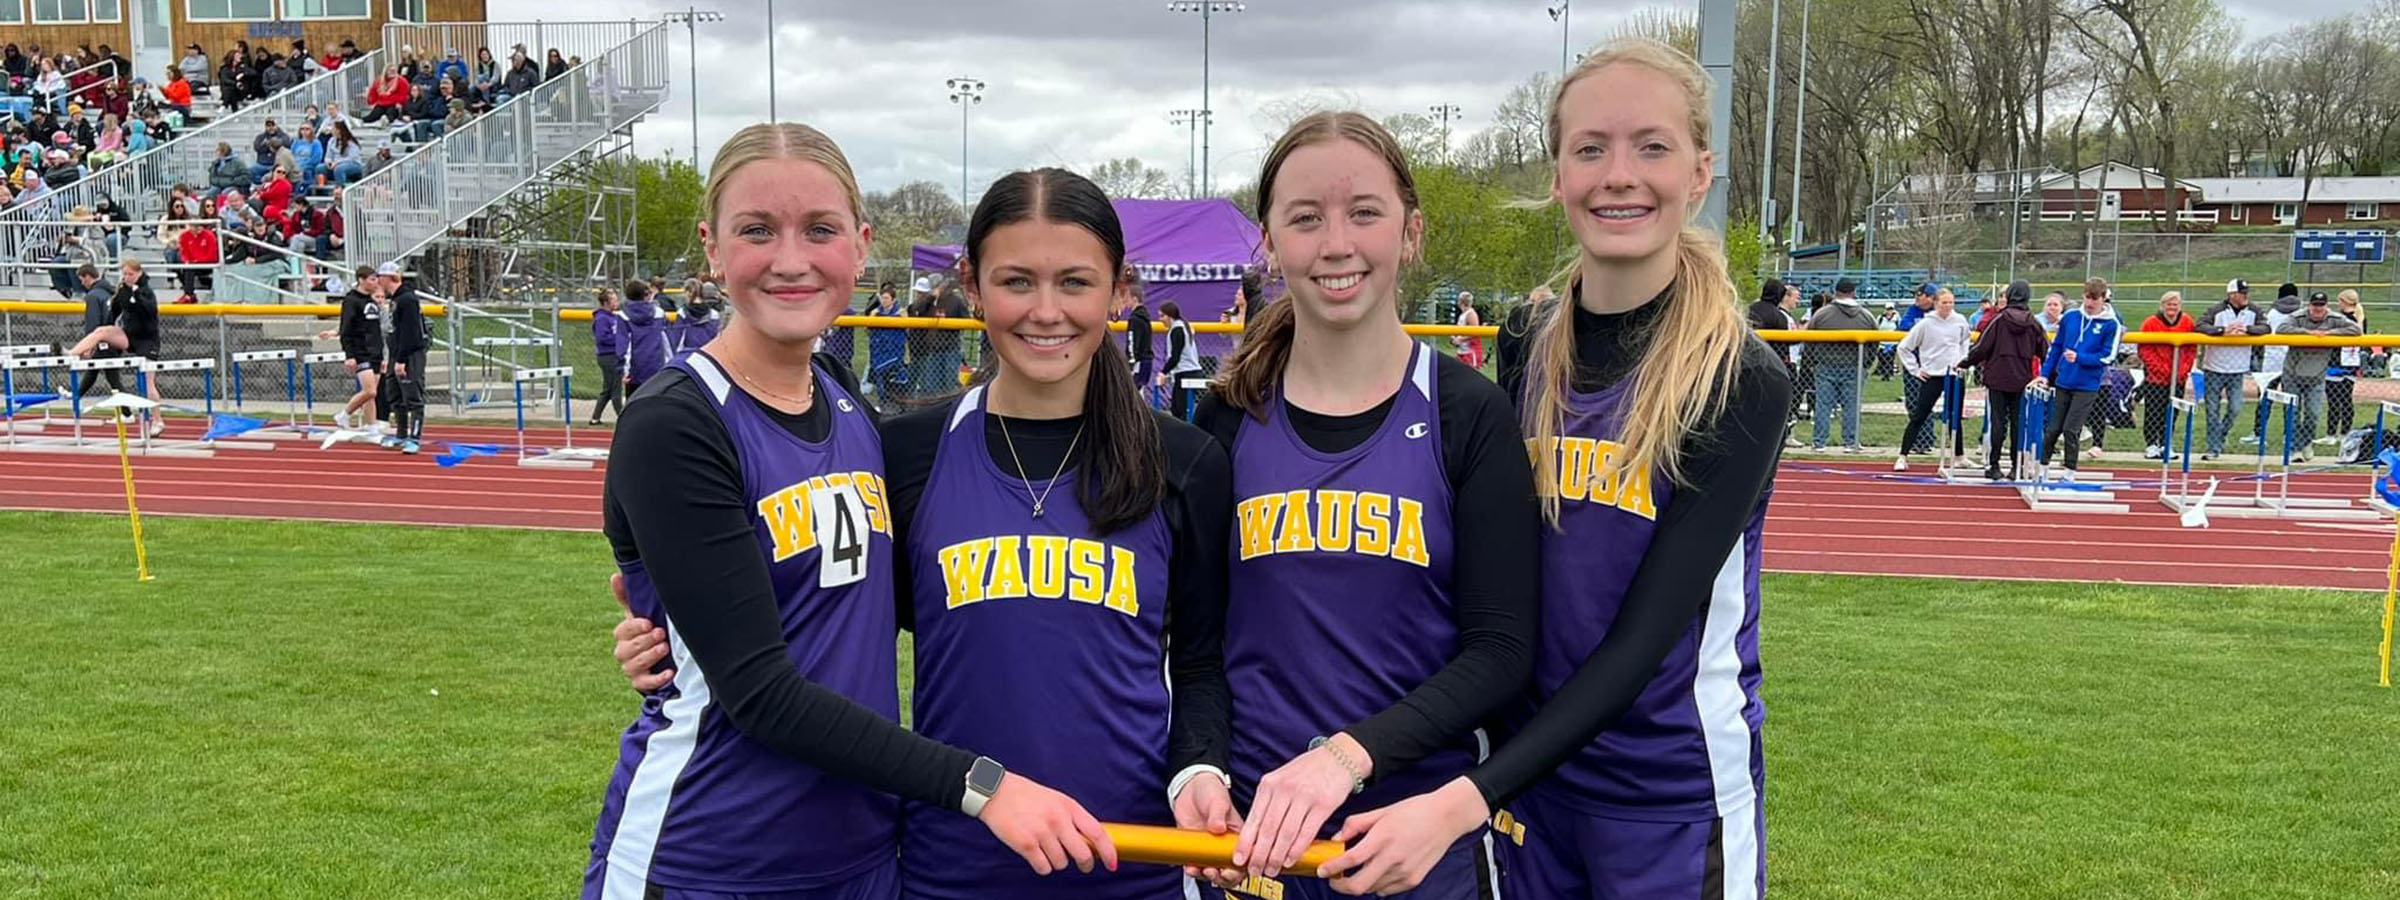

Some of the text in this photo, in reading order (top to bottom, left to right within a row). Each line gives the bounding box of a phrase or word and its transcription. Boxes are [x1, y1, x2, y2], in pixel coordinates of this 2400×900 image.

[833, 492, 863, 576] 4
[1237, 489, 1430, 567] WAUSA
[938, 535, 1140, 617] WAUSA
